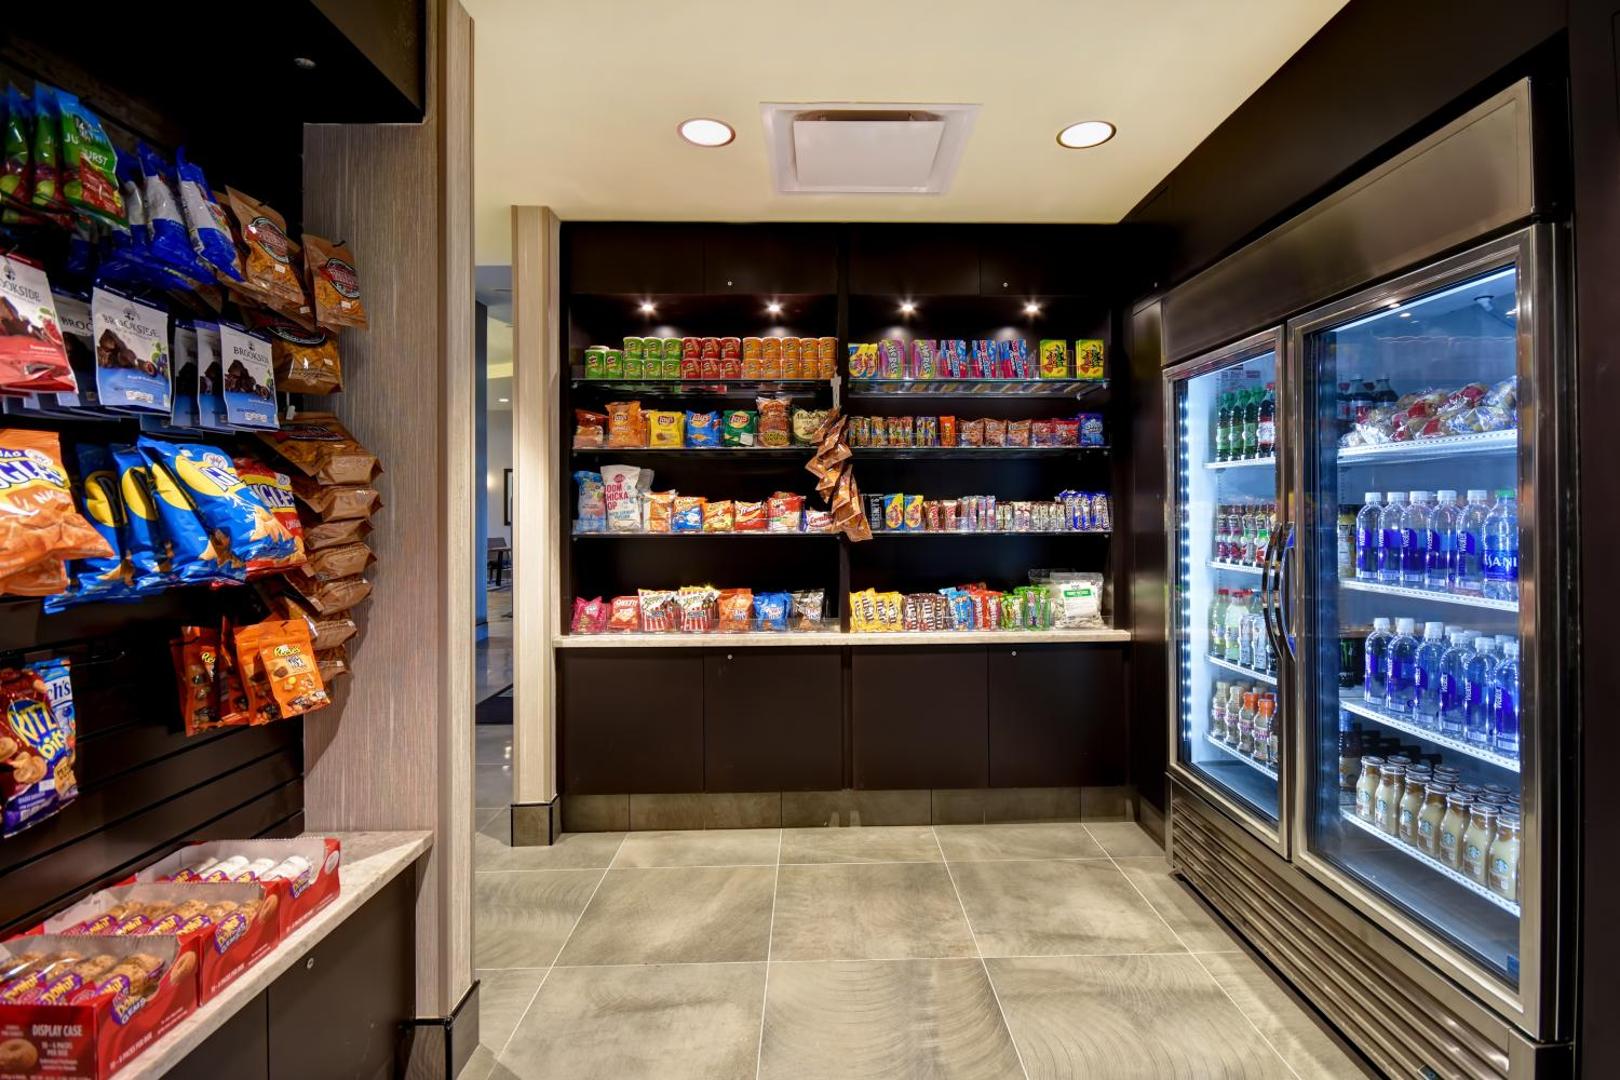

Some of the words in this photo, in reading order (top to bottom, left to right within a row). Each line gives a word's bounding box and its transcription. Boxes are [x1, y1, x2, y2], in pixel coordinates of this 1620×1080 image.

[102, 313, 161, 338] BROOKSIDE
[605, 483, 623, 493] OOM
[605, 491, 630, 502] HICKA
[606, 500, 618, 511] OP
[32, 1024, 62, 1037] DISPLAY
[63, 1024, 83, 1037] CASE
